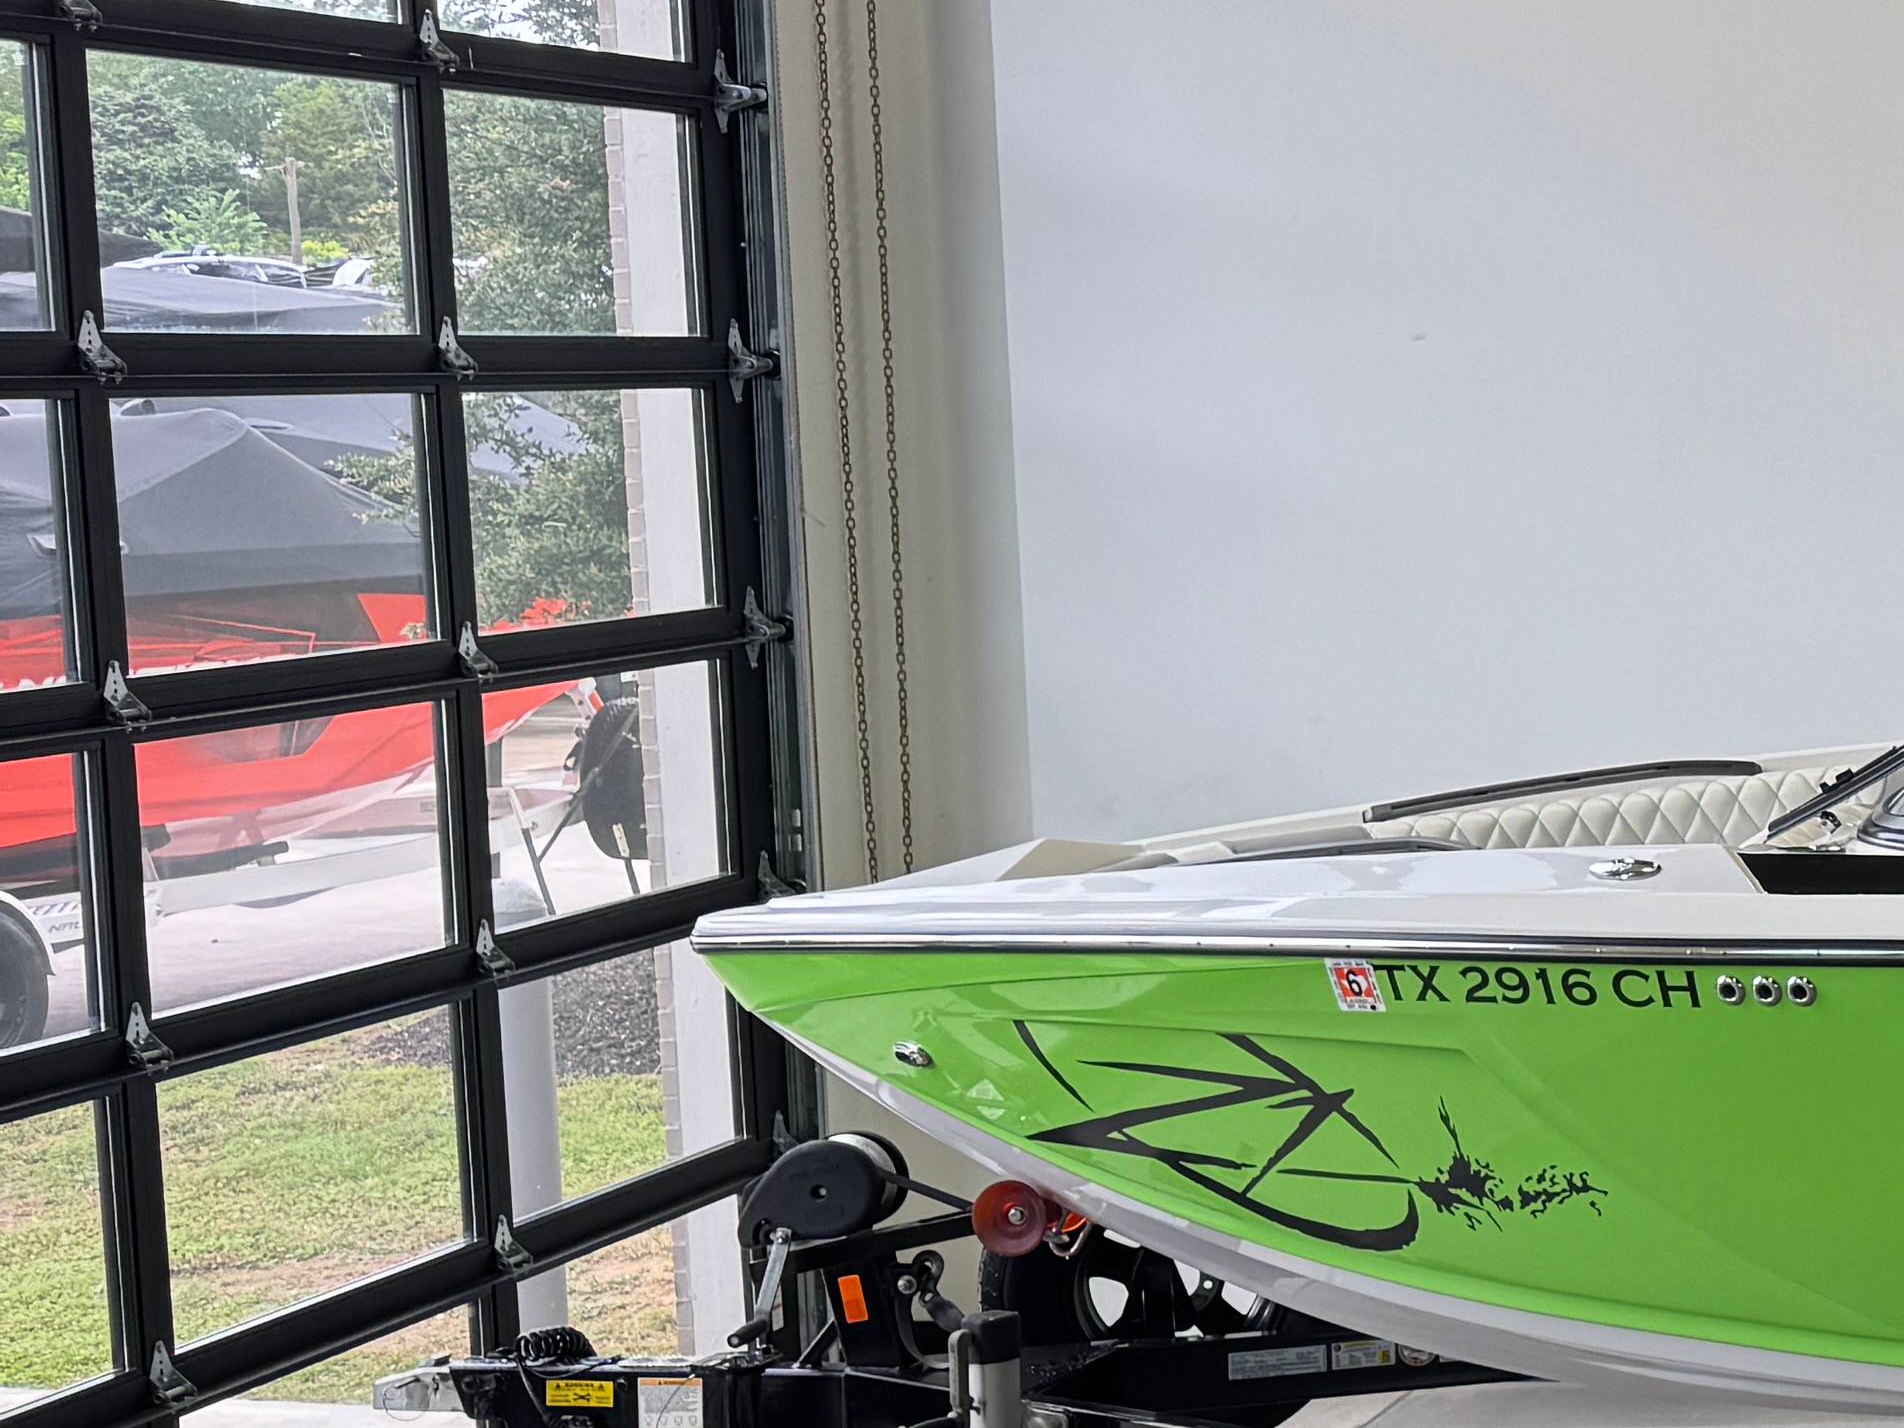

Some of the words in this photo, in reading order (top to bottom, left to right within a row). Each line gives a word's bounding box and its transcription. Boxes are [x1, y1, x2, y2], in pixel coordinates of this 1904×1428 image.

[1346, 969, 1363, 997] 6
[1372, 964, 1448, 1002] TX
[1459, 967, 1599, 1006] 2916
[1613, 969, 1702, 1008] CH
